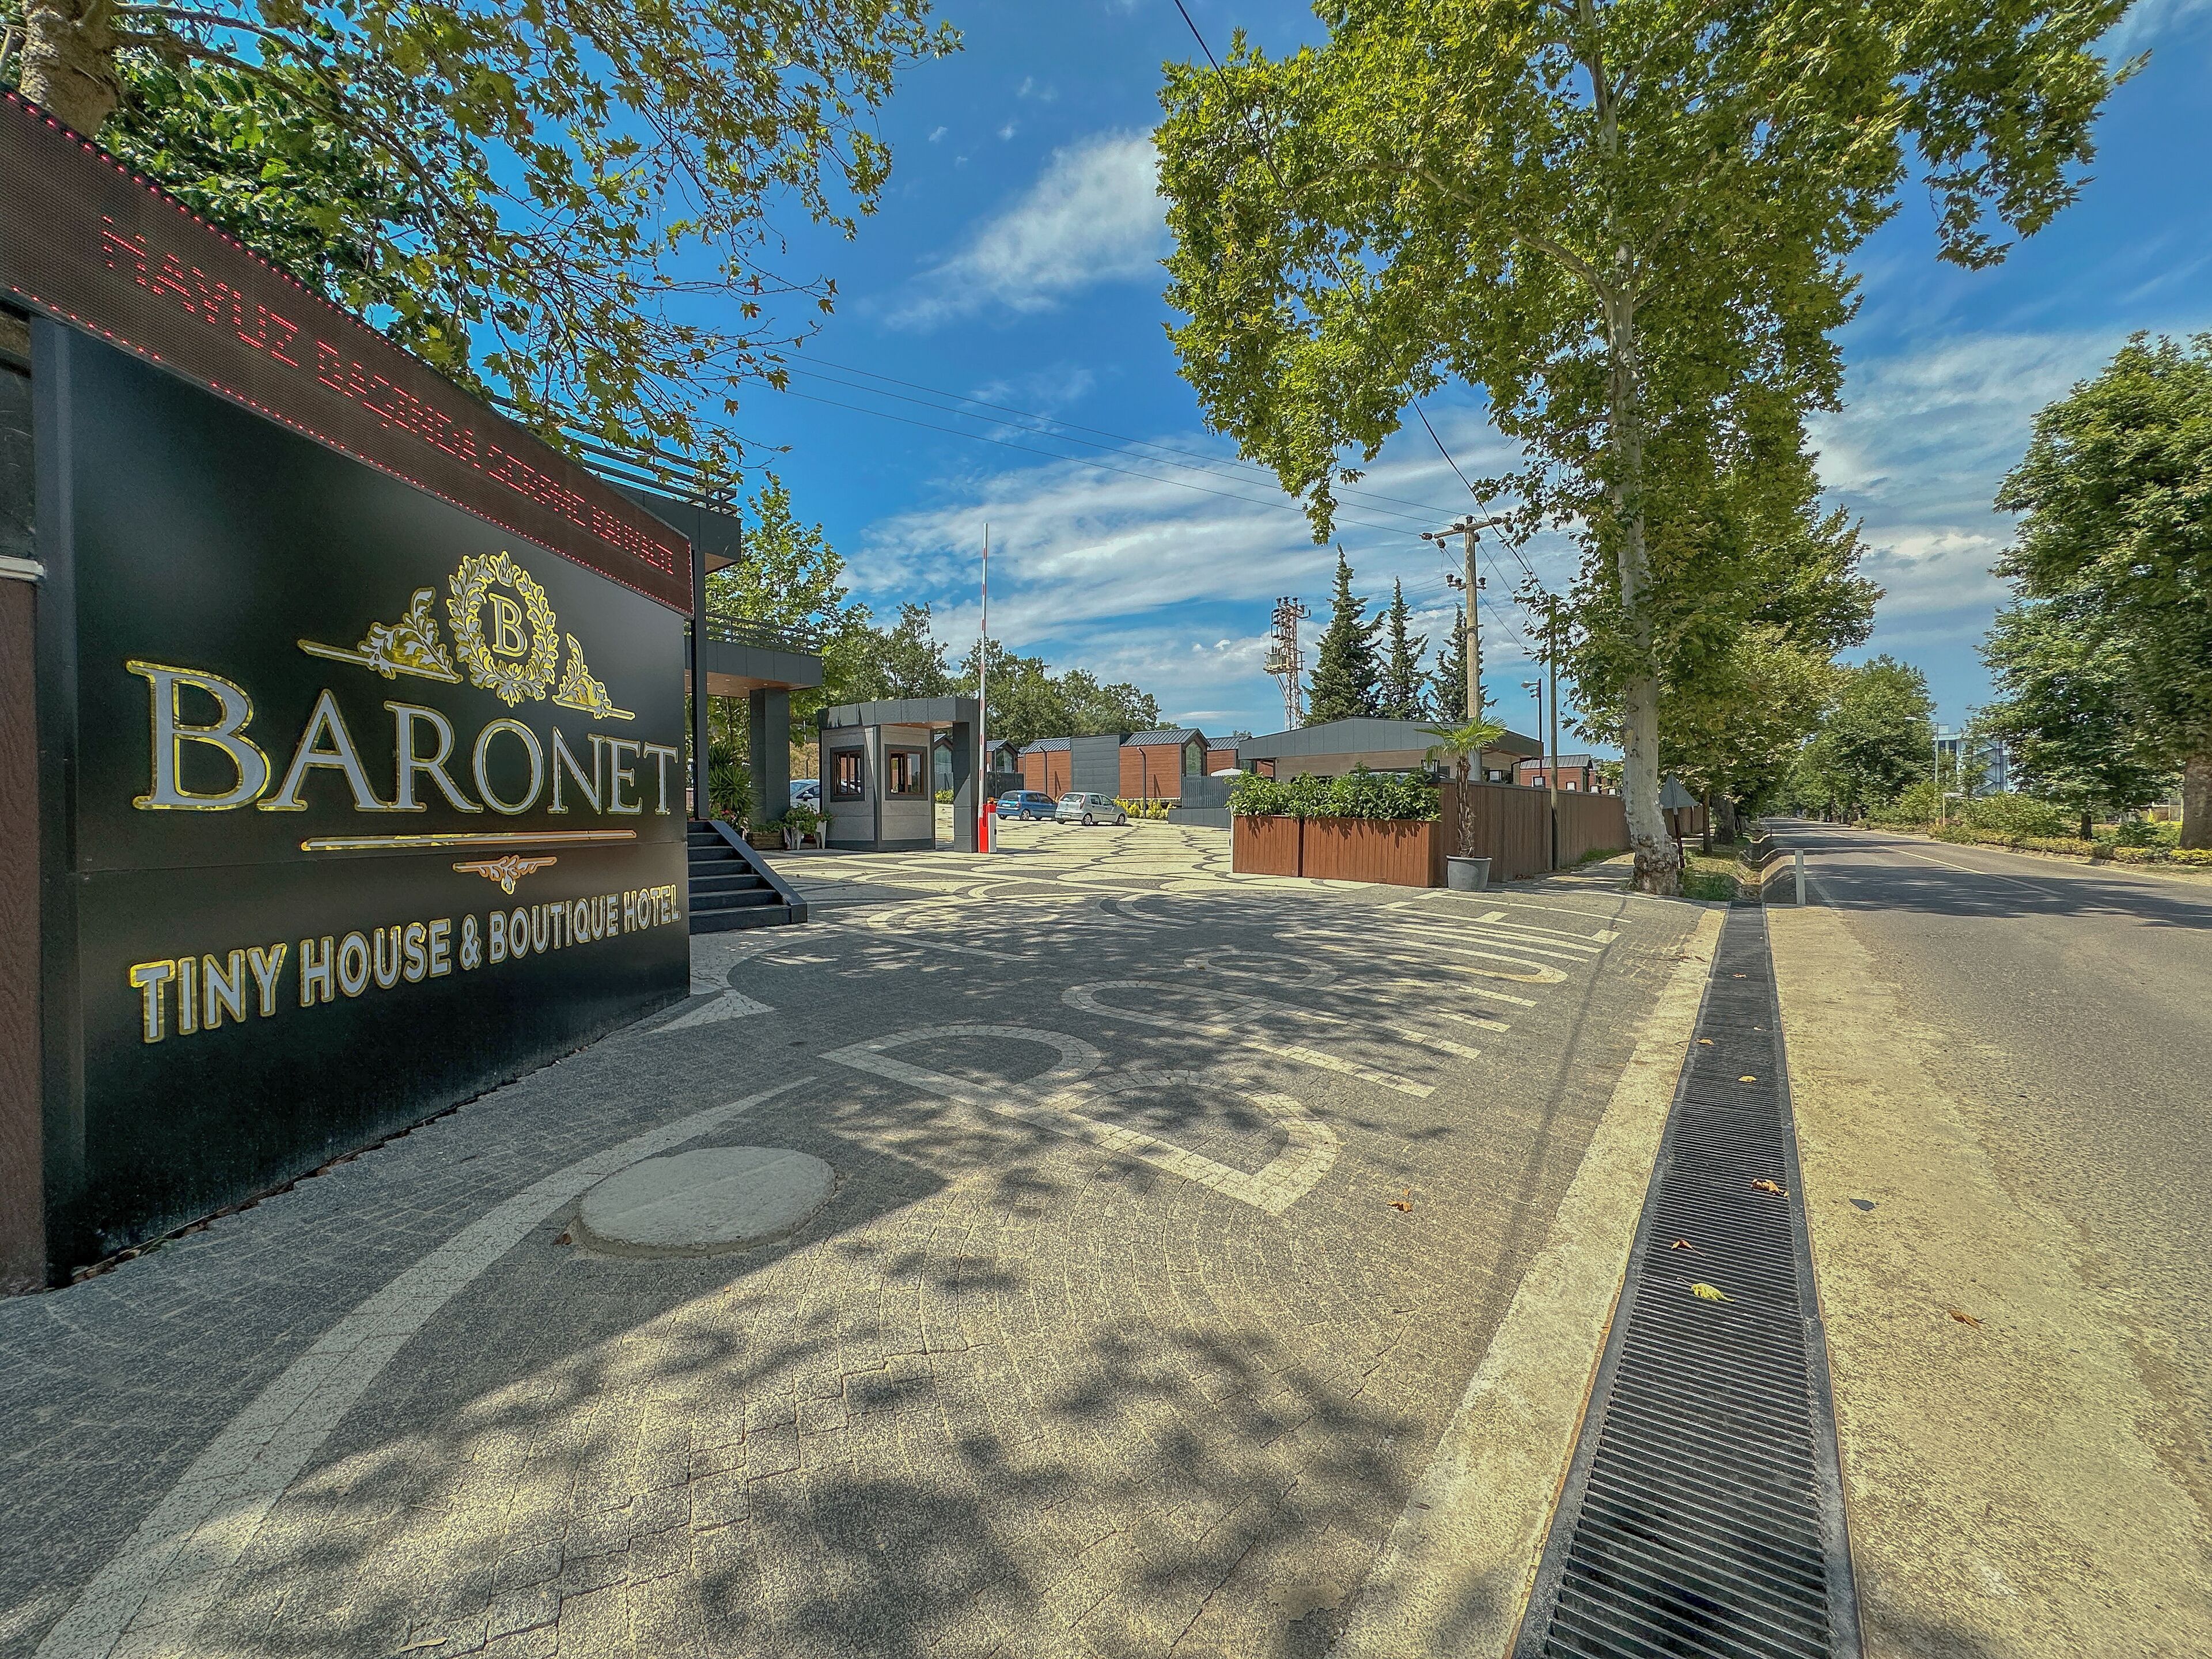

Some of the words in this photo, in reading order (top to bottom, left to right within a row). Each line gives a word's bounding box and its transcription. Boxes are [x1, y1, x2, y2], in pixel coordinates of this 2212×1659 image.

[488, 591, 529, 657] B
[125, 659, 679, 816] BARONET
[129, 942, 287, 1044] TINY
[300, 917, 452, 1008] HOUSE
[460, 915, 481, 970] &
[489, 893, 620, 964] BOUTIQUE
[622, 884, 681, 933] HOTEL
